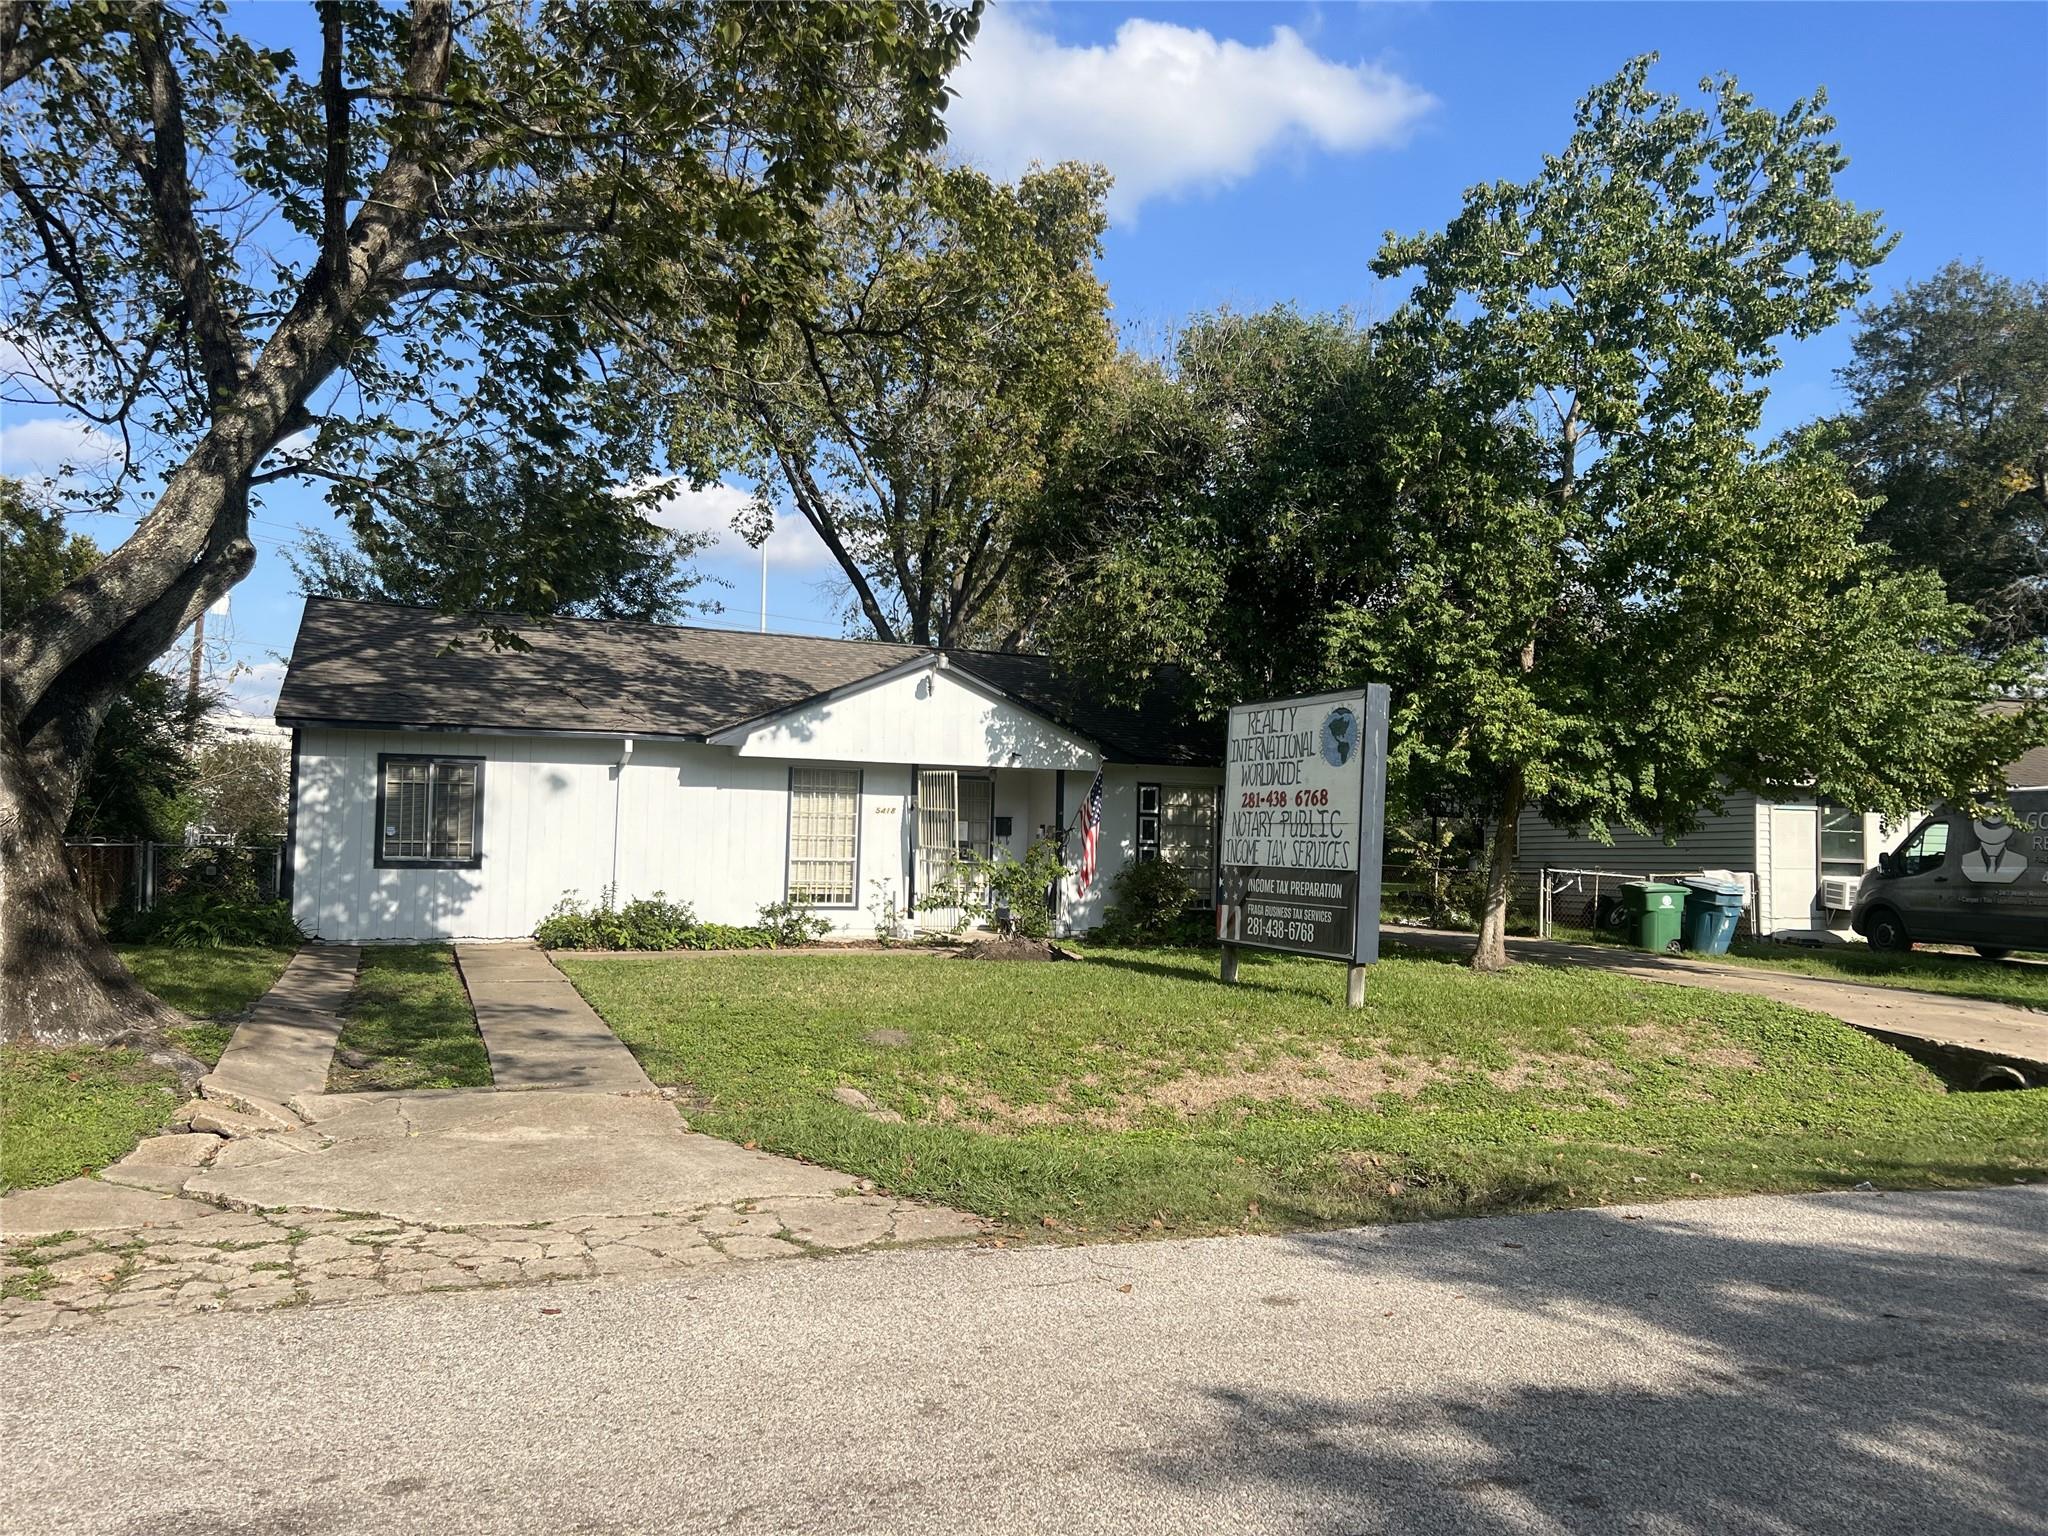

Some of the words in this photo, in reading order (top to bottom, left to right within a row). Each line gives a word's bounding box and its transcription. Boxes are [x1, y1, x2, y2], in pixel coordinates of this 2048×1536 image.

[1248, 707, 1297, 735] REALTY
[1230, 731, 1316, 763] INTERNATIONAL
[1241, 760, 1304, 787] WORLDWIDE
[1241, 790, 1287, 808] 281-438
[1295, 788, 1329, 807] 6768
[1232, 809, 1275, 837] NOTARY
[1280, 809, 1343, 838] PUBLIC
[1226, 839, 1260, 865] INCOME
[1267, 840, 1287, 866] TAX
[1291, 841, 1350, 869] SERVICES
[1247, 878, 1274, 893] INCOME
[1275, 880, 1289, 894] TAX
[1290, 882, 1343, 899] PREPARATION
[1247, 904, 1264, 916] FRAGA
[1264, 906, 1292, 919] BUSINESS
[1292, 908, 1303, 920] TAX
[1303, 910, 1332, 922] SERVICES
[1247, 917, 1315, 942] 281-438-6768
